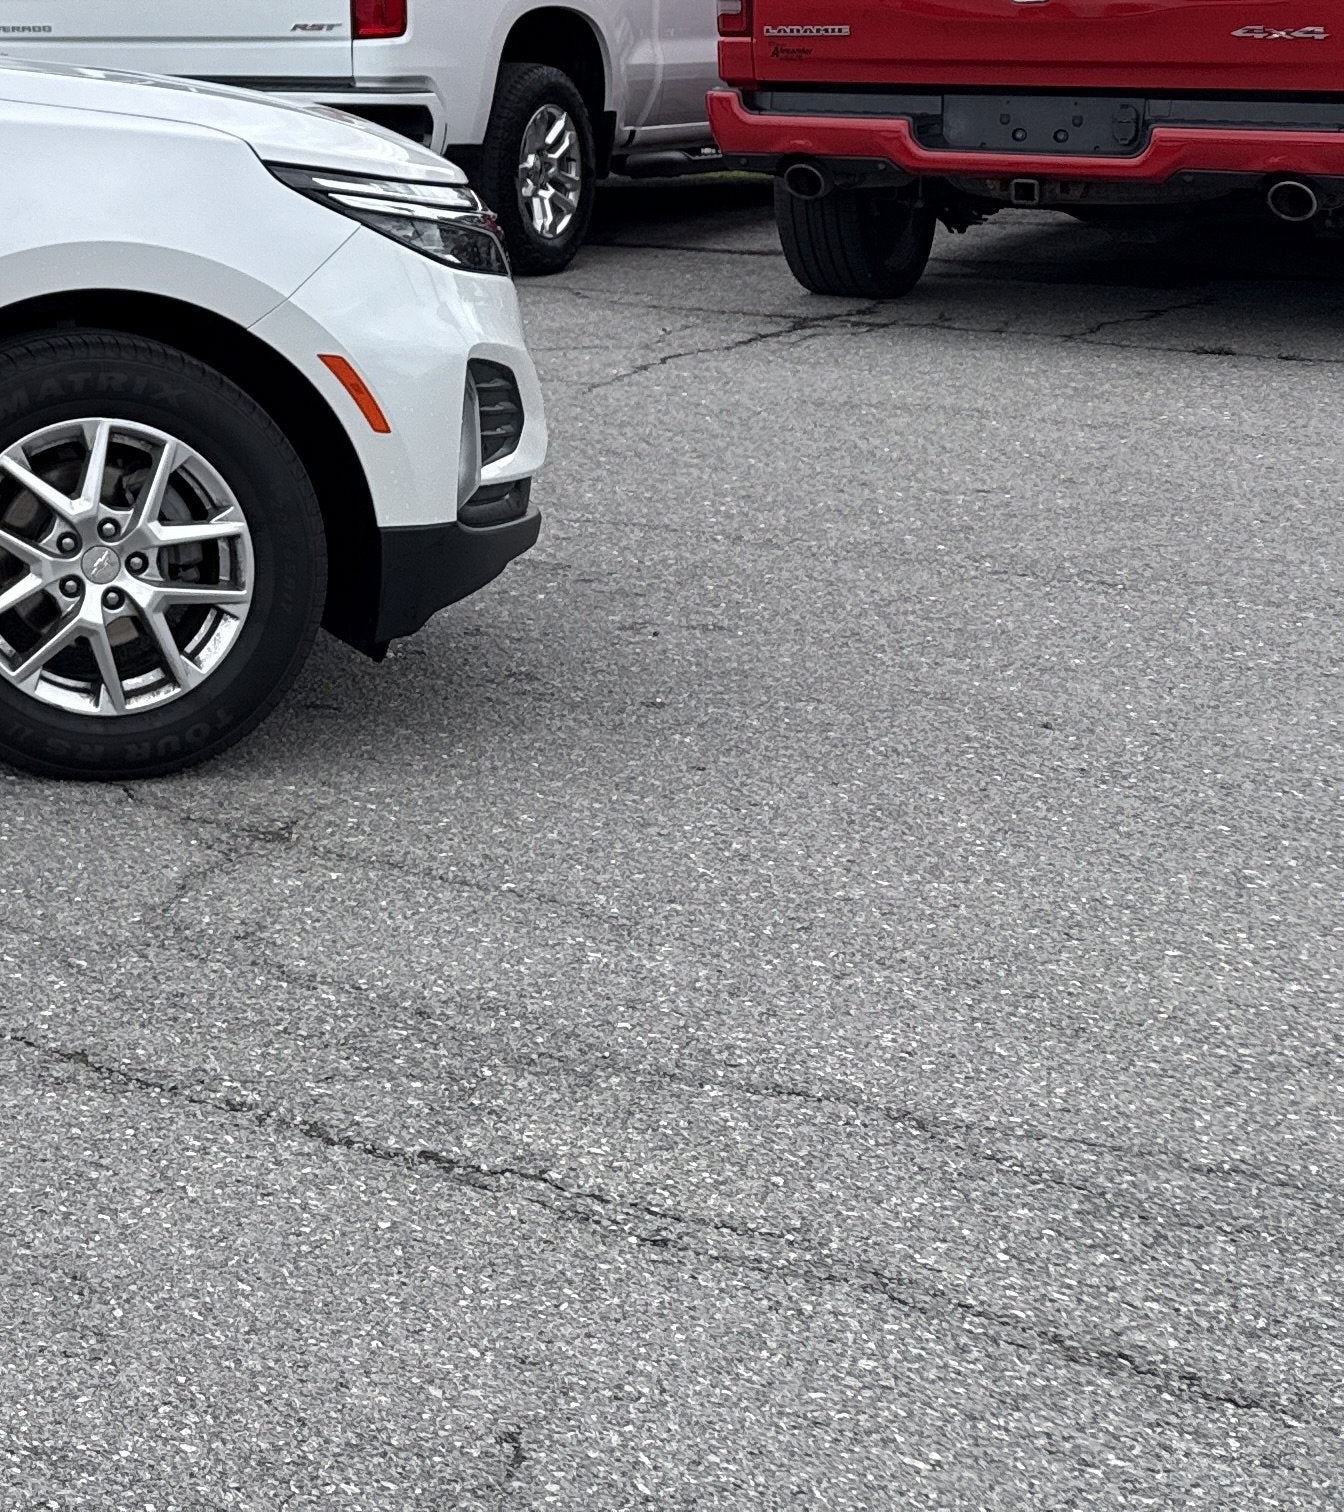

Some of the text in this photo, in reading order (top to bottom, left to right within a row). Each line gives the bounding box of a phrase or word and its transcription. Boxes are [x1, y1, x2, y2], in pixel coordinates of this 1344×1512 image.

[290, 23, 343, 32] RST
[764, 25, 850, 36] LARAMIE
[123, 706, 234, 762] TOUR
